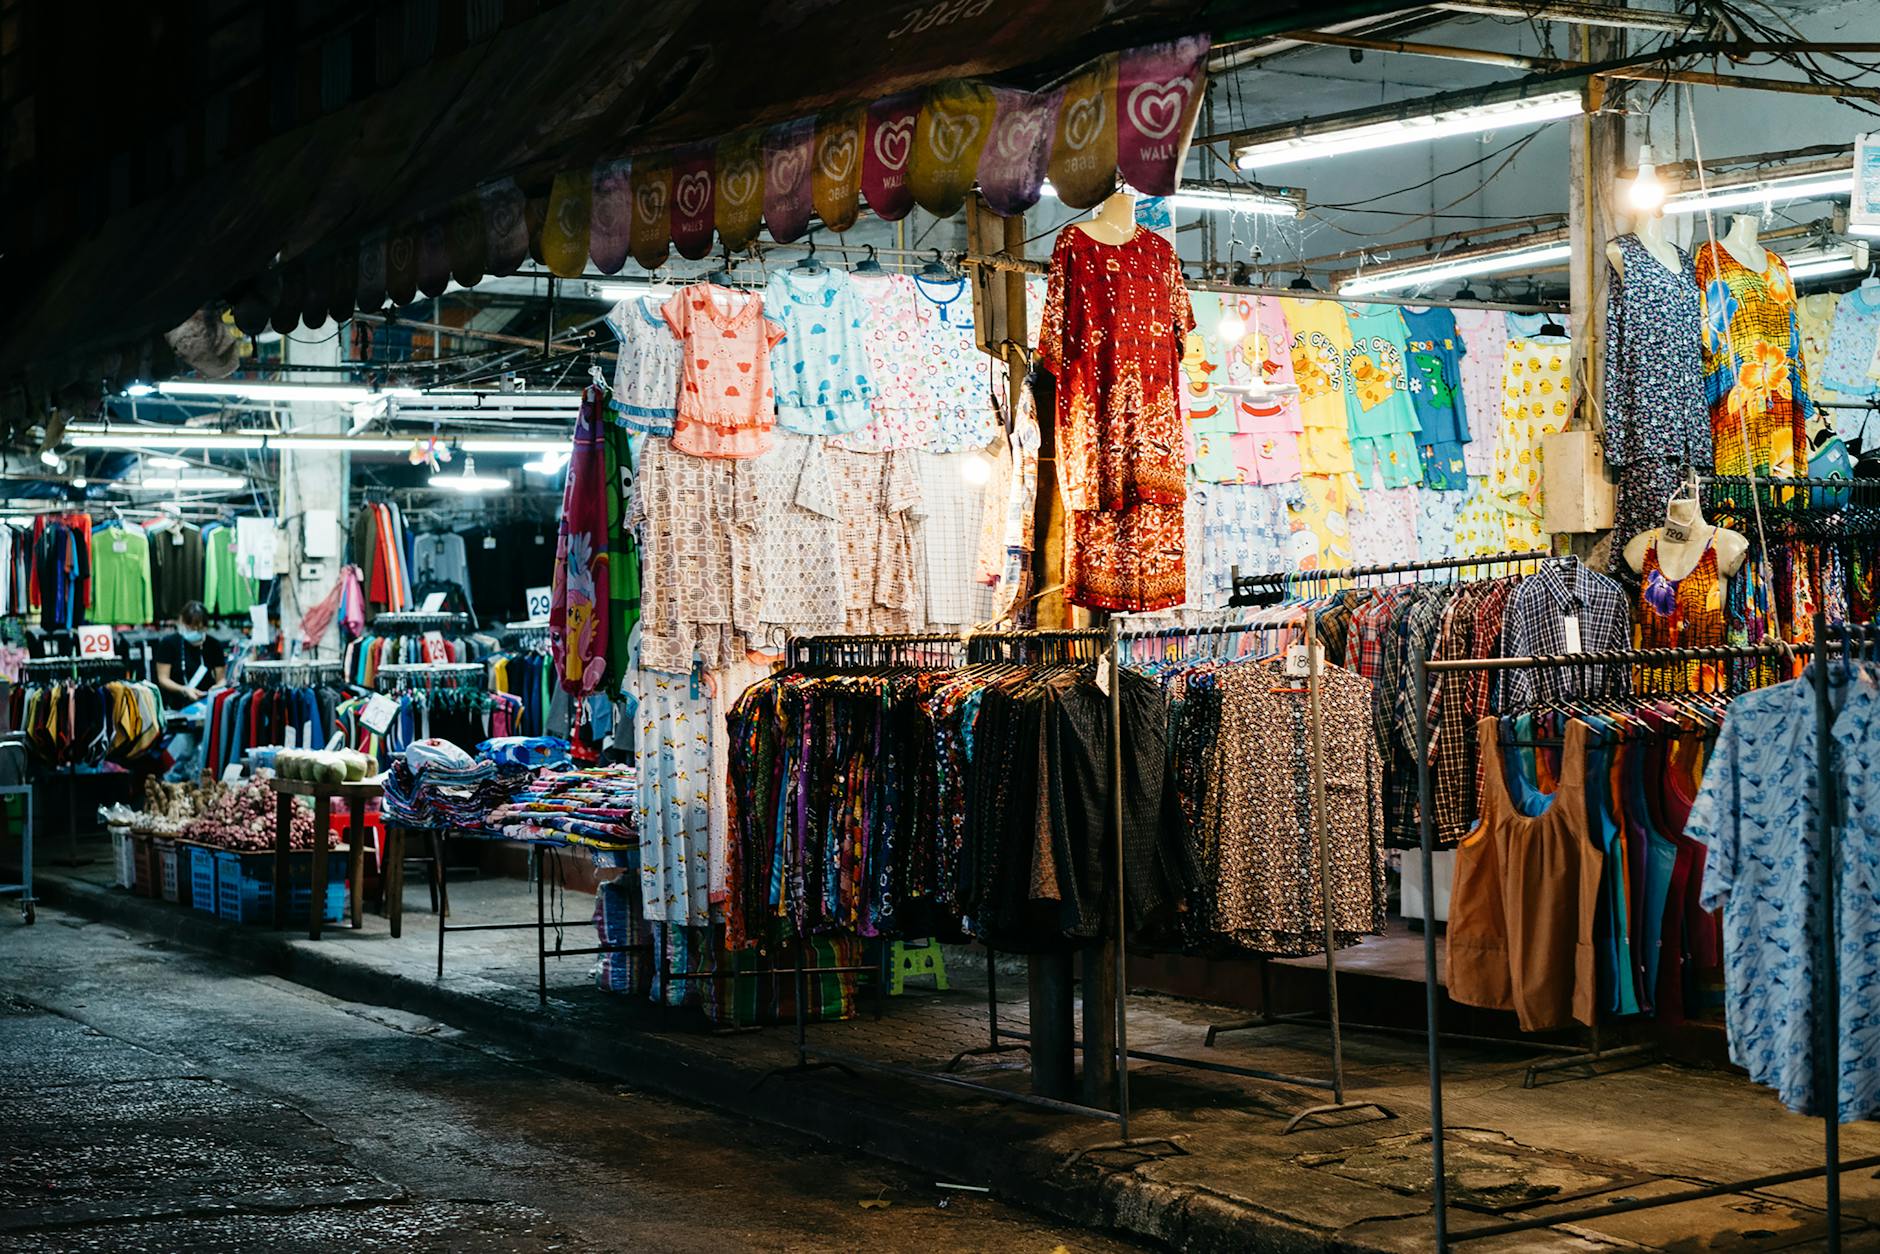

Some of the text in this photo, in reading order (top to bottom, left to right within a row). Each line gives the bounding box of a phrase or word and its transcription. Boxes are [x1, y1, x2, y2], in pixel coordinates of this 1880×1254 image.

[530, 595, 550, 616] 29
[83, 634, 110, 653] 29
[430, 640, 445, 660] 29
